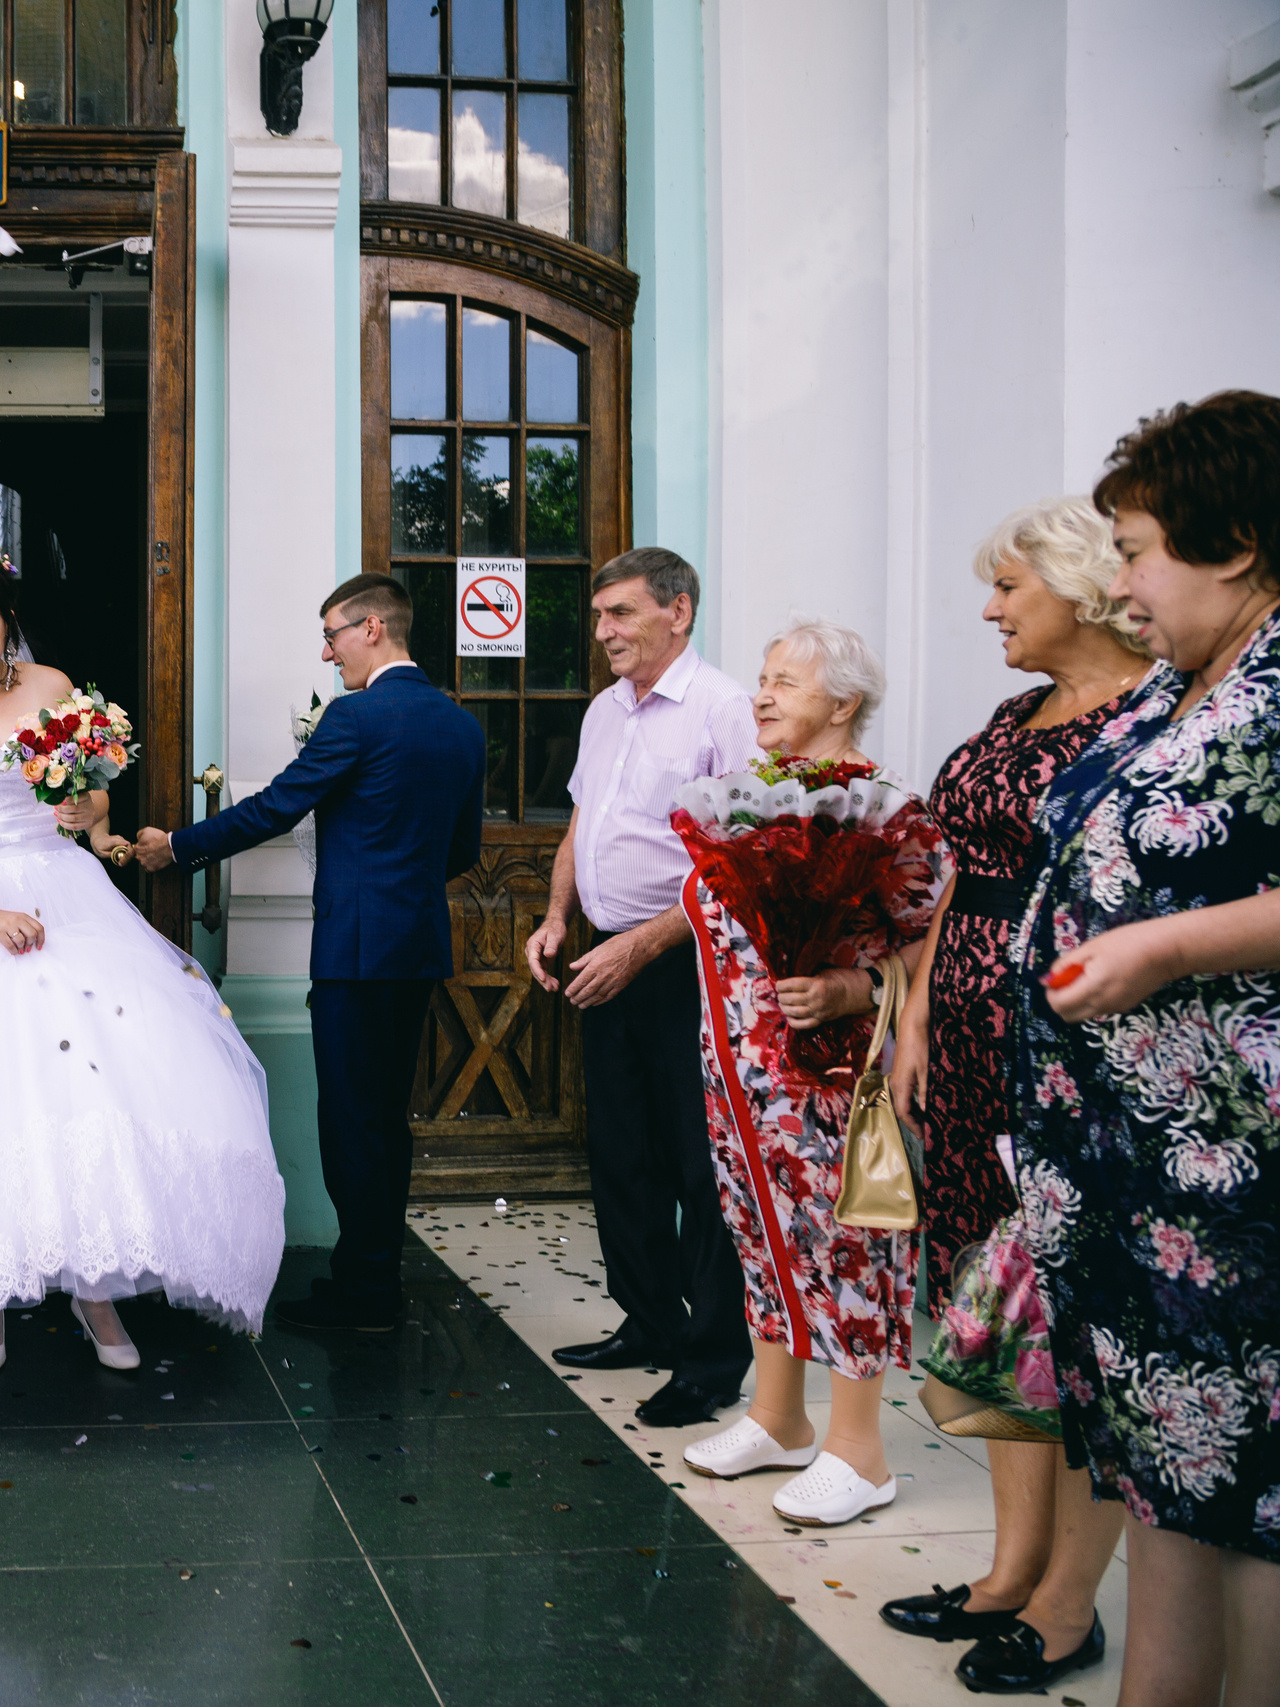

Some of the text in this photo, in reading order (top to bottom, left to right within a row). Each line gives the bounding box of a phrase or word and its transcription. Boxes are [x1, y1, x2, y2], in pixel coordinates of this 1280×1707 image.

[461, 563, 522, 572] НЕ КУРИТЬ!
[477, 644, 522, 652] SMOKING!
